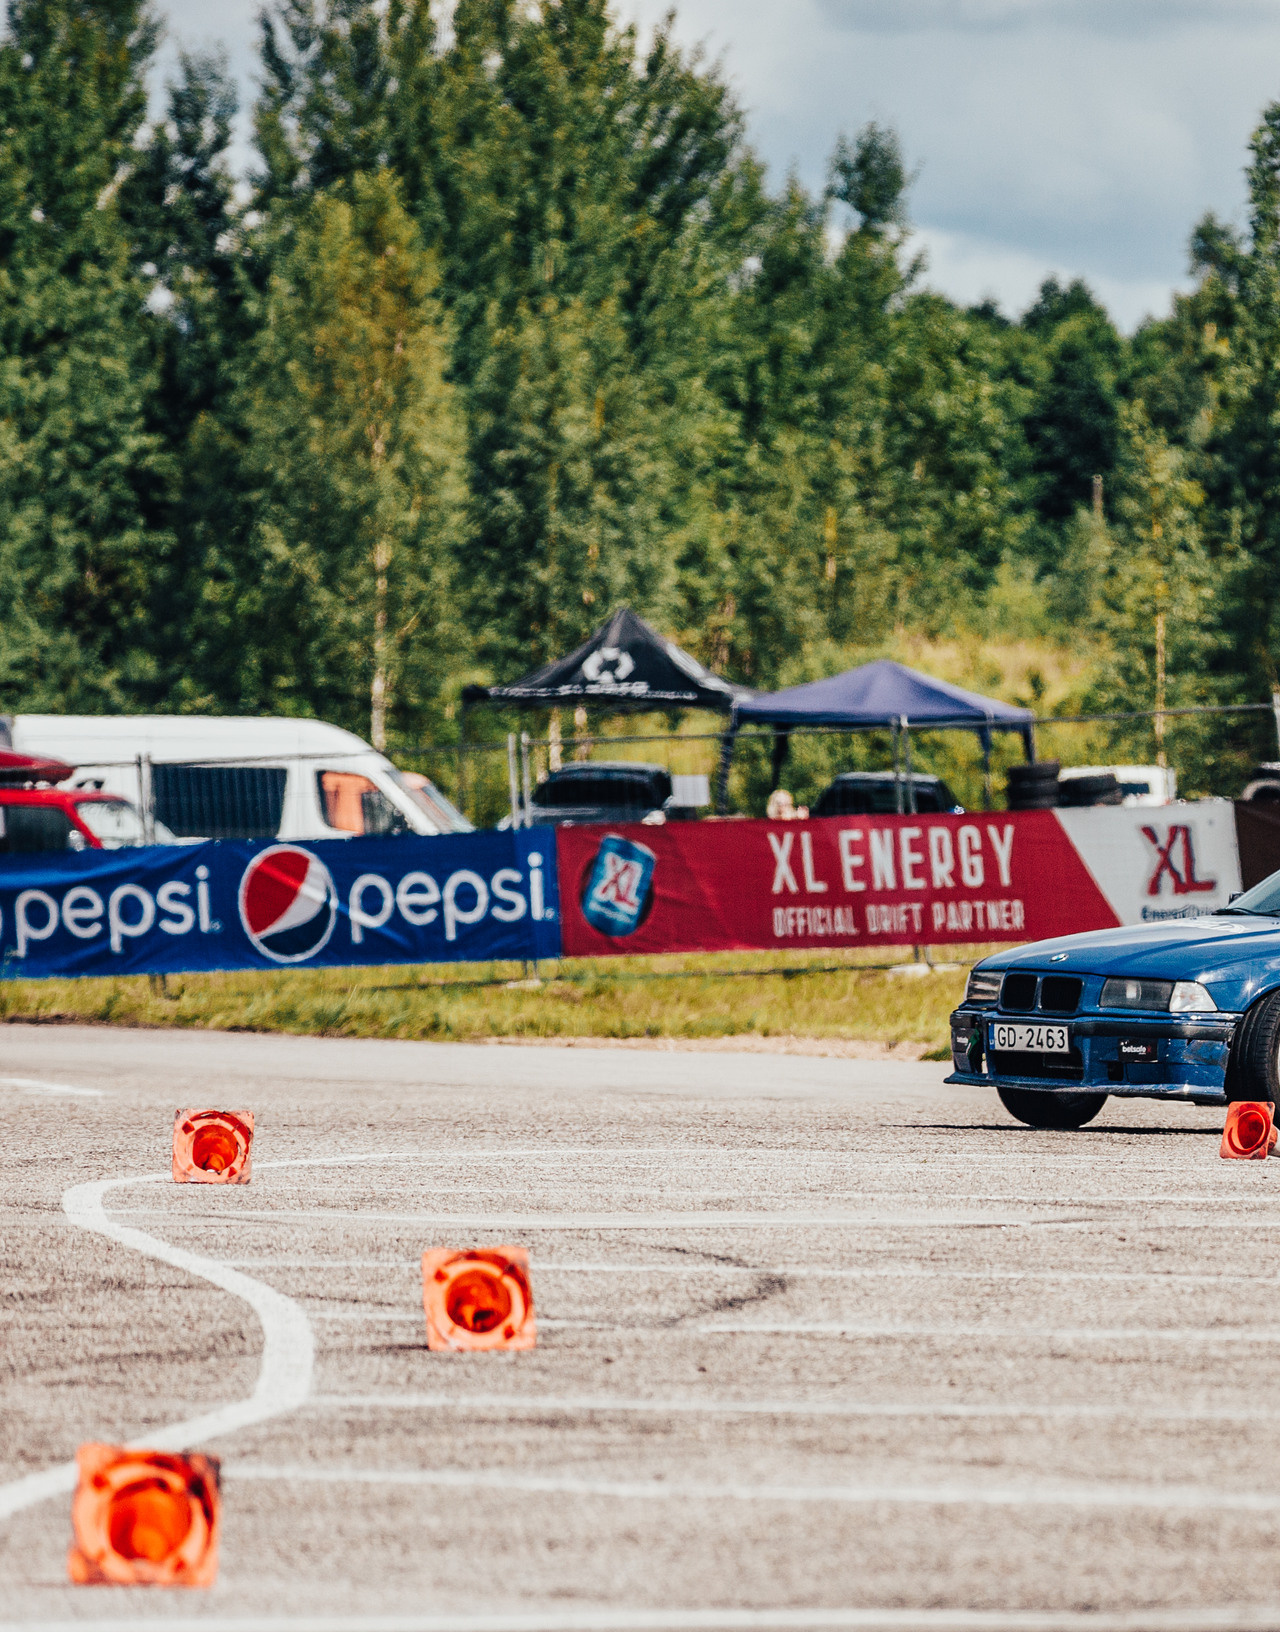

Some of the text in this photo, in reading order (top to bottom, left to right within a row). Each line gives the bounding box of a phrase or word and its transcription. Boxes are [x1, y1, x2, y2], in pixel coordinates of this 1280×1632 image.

[767, 824, 1015, 894] XL ENERGY
[1141, 825, 1216, 895] XL
[14, 865, 210, 958] pepsi
[349, 852, 544, 943] pepsi
[772, 899, 1025, 937] OFFICIAL DRIFT PARTNER
[998, 1027, 1065, 1049] GD-2463
